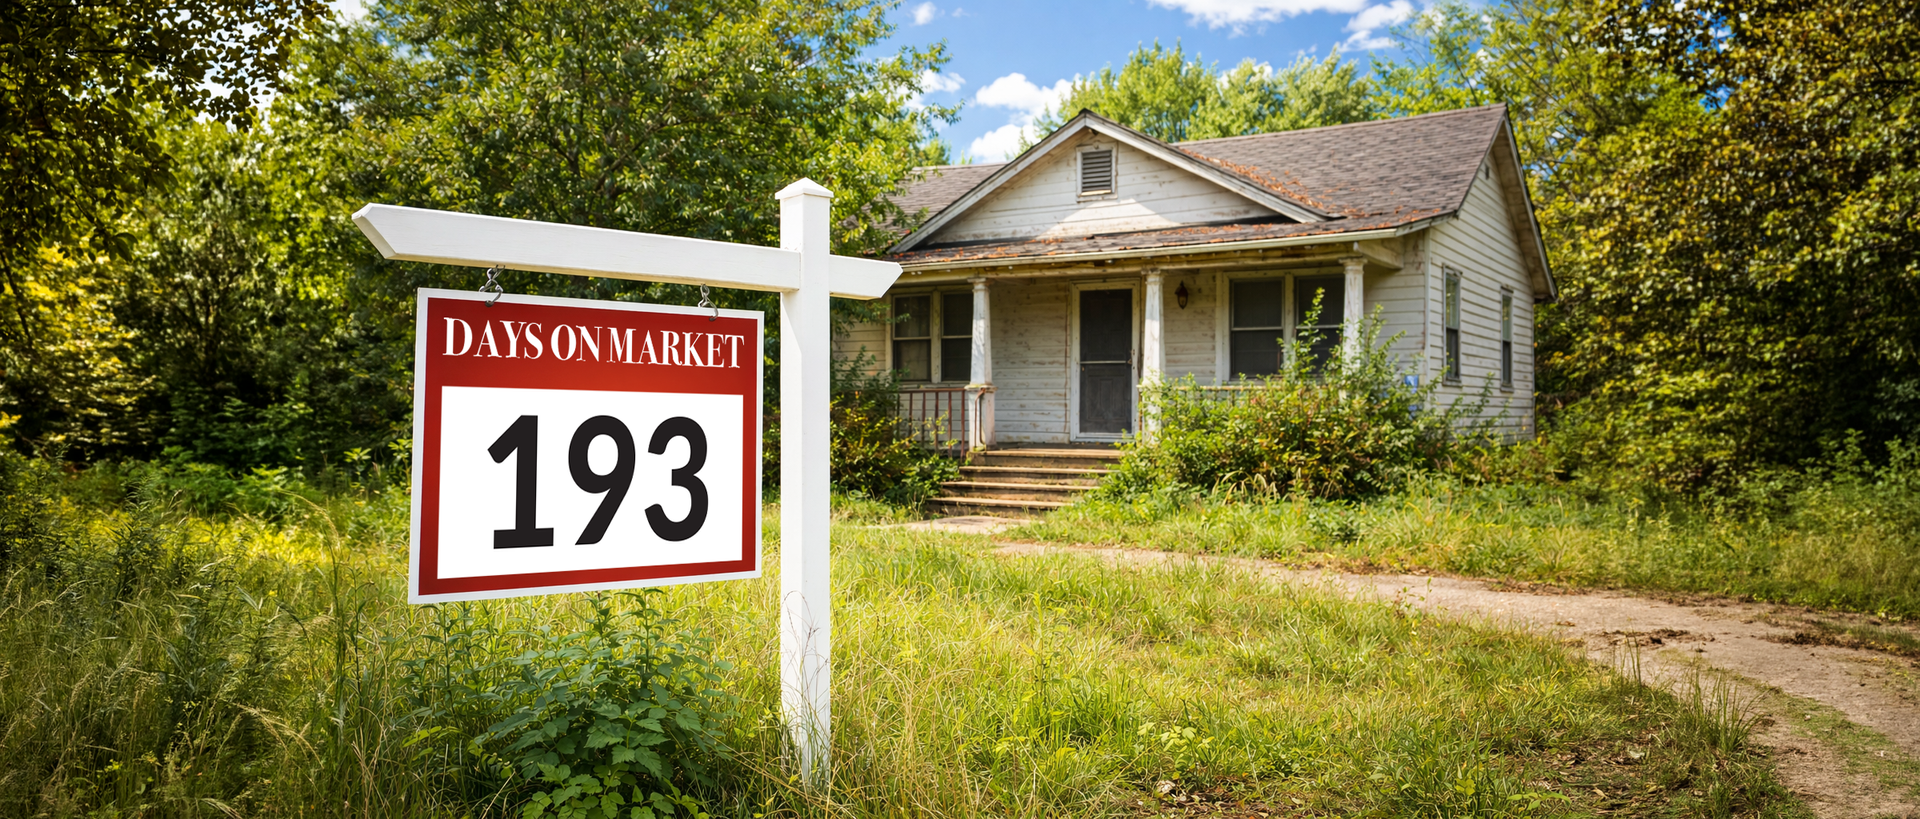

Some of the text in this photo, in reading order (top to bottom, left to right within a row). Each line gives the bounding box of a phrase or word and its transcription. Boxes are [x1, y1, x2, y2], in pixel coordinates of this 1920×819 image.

[443, 317, 745, 368] DAYS ON MARKET
[487, 414, 709, 550] 193
